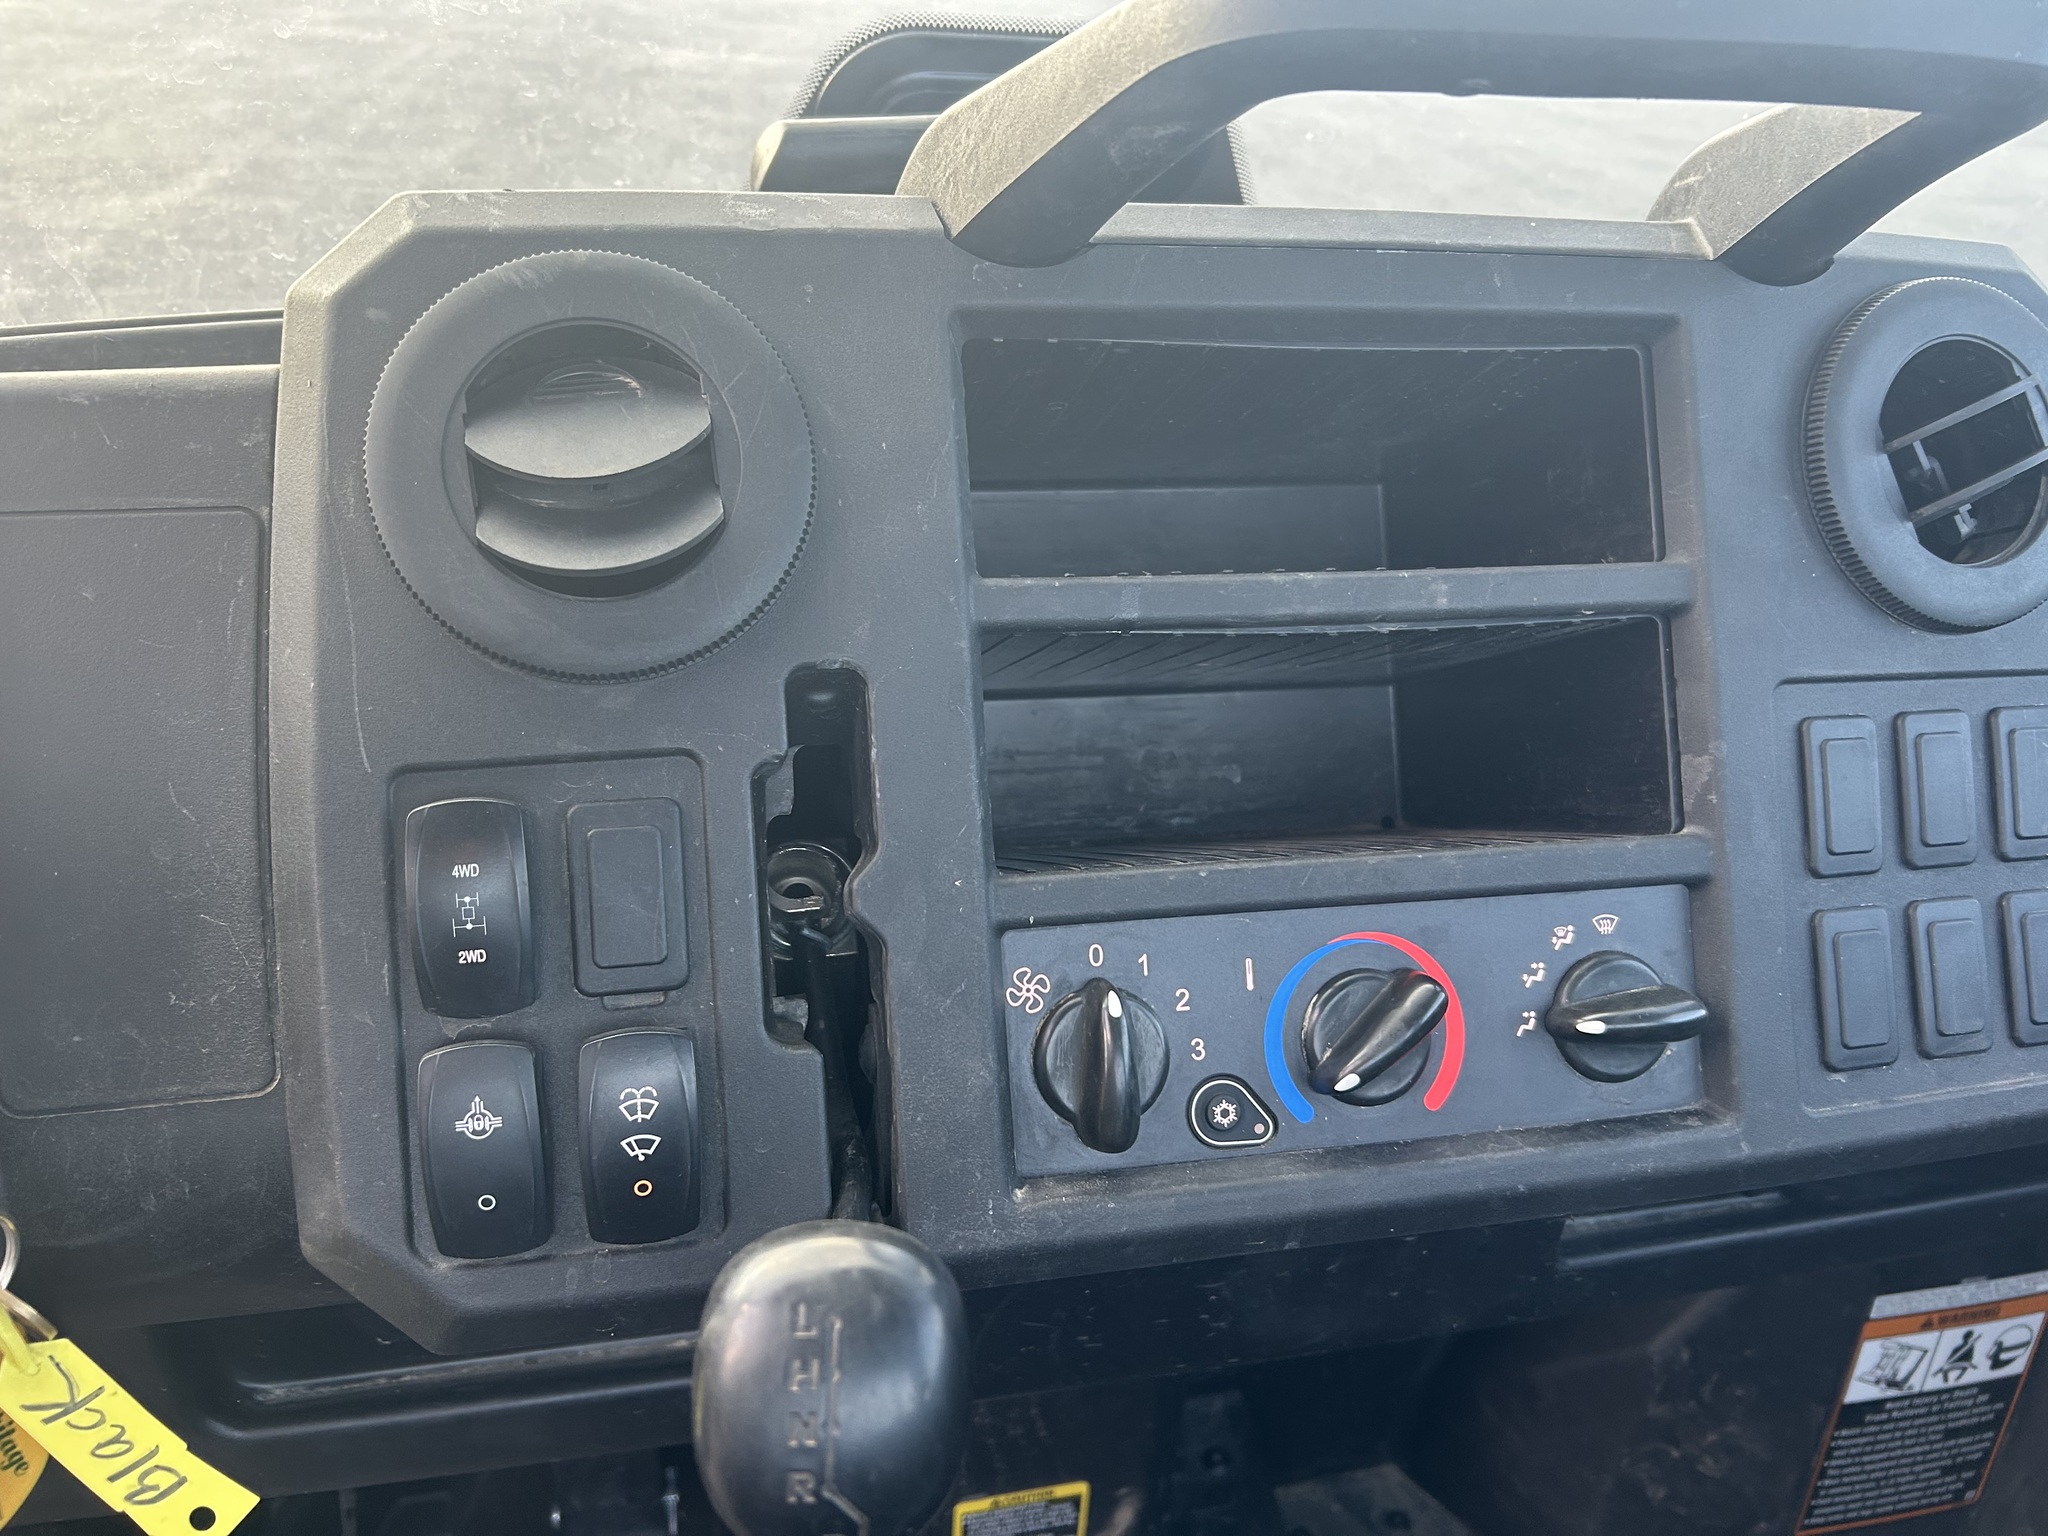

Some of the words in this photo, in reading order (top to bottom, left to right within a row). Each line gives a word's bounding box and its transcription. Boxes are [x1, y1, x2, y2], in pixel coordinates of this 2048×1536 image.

[451, 863, 480, 880] 4WD
[457, 949, 487, 965] 2WD
[1088, 943, 1104, 967] 0
[1138, 953, 1149, 976] 1
[1175, 988, 1191, 1012] 2
[1190, 1037, 1206, 1061] 3
[793, 1302, 818, 1338] L
[789, 1358, 820, 1391] H
[787, 1411, 818, 1448] N
[785, 1472, 818, 1504] R
